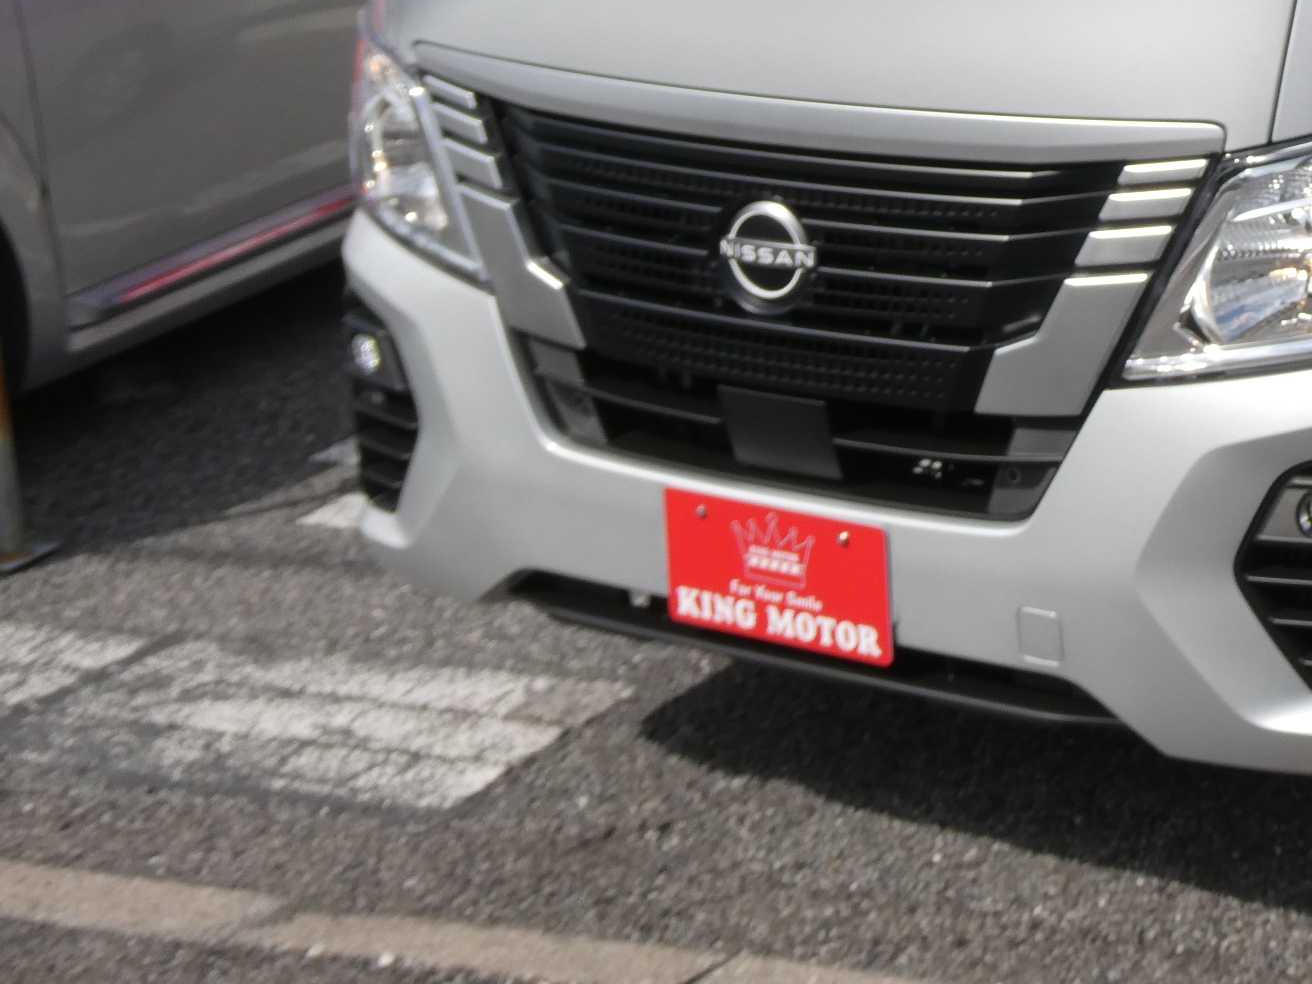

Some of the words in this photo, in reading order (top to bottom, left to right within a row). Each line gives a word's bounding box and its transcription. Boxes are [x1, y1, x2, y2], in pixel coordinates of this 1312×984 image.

[720, 239, 815, 268] NISSAN
[675, 585, 758, 630] KING
[765, 606, 883, 658] MOTOR
